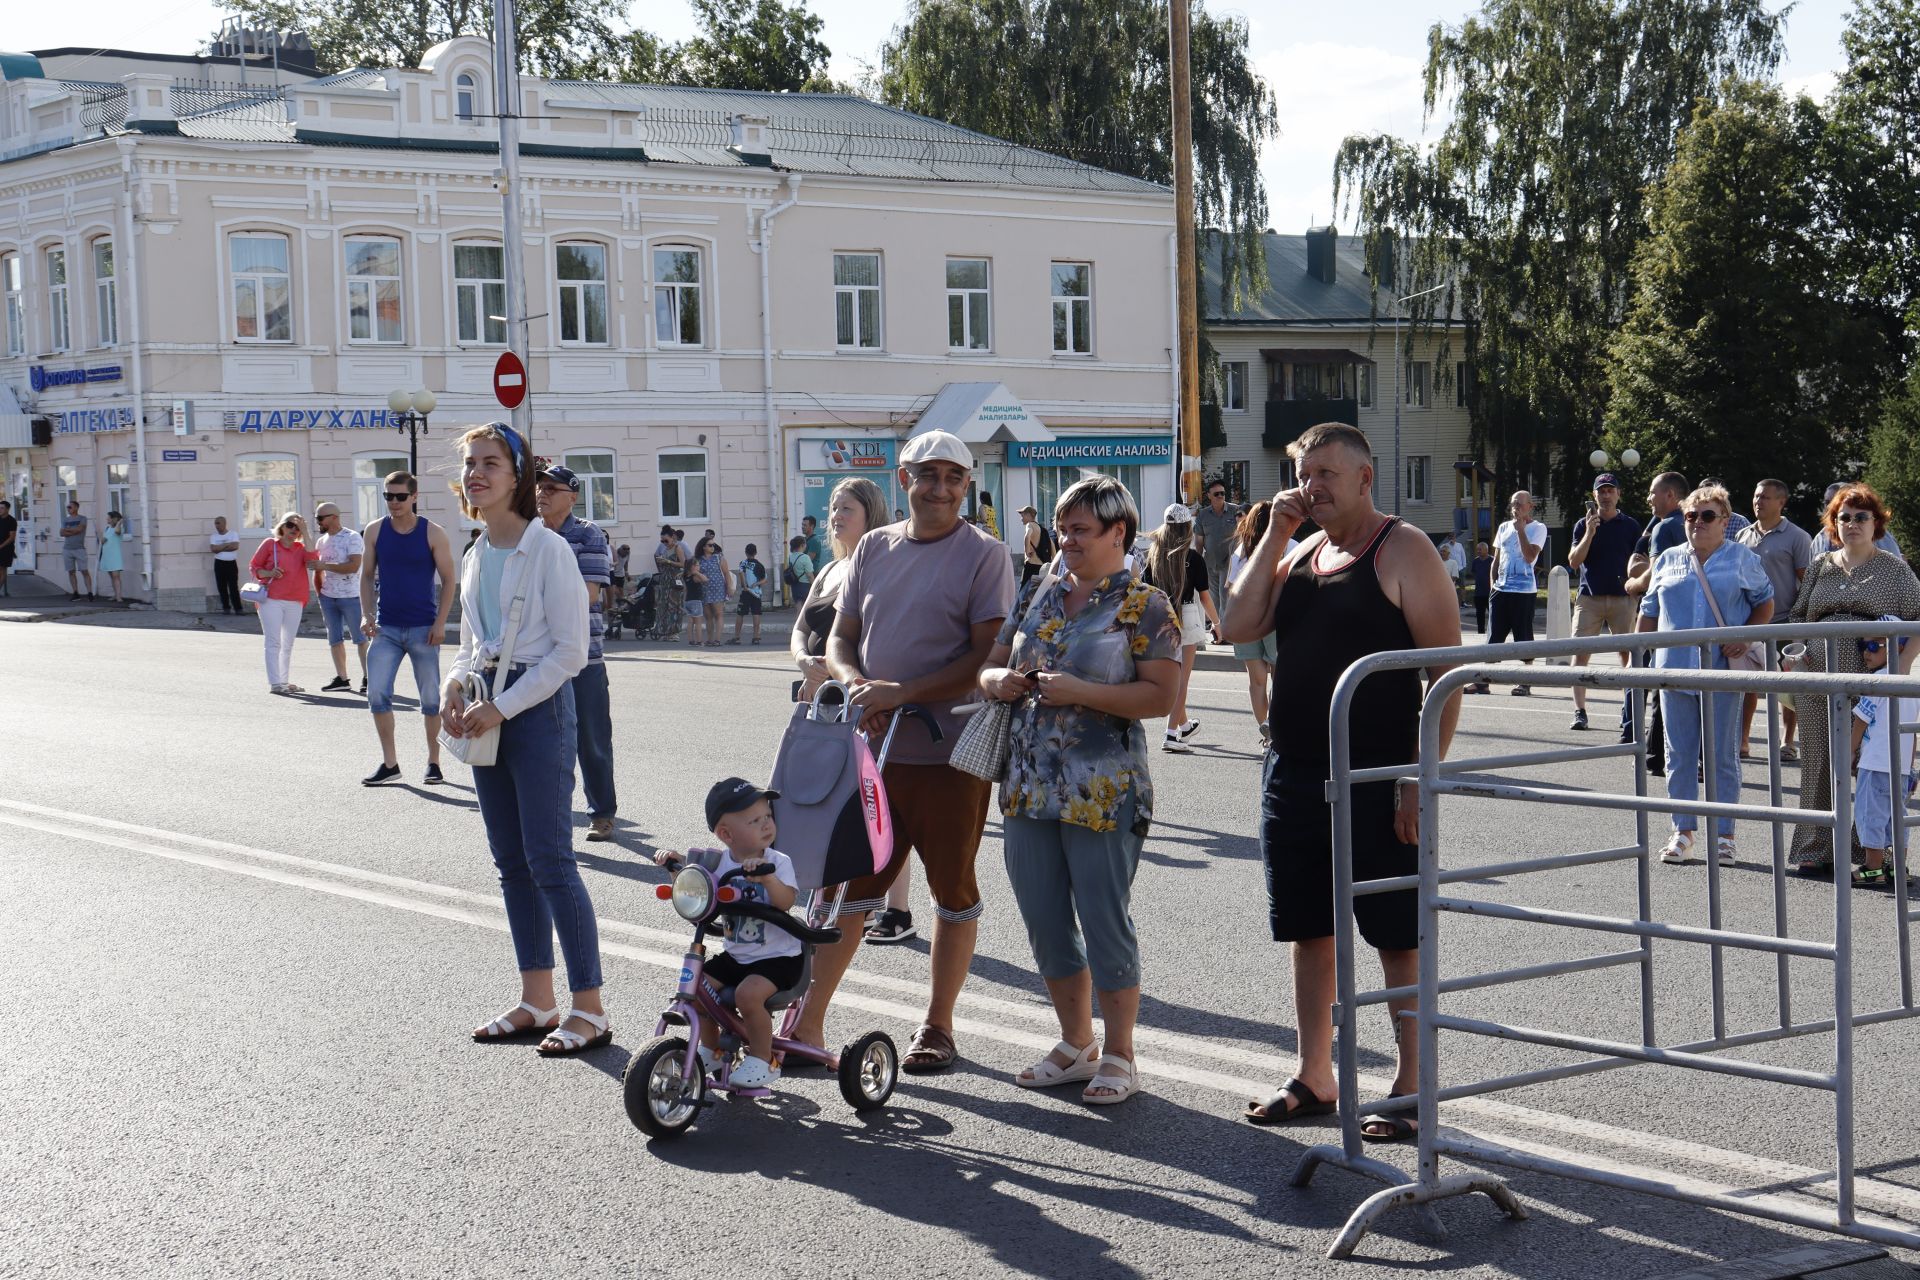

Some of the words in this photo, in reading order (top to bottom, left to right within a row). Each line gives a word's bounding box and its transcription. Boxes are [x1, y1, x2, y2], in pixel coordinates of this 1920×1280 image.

[45, 369, 86, 387] ЮГОРИЯ
[982, 405, 1023, 413] МЕДИЦИНА
[60, 409, 118, 433] АПТЕКА
[852, 442, 886, 456] KDL
[1020, 445, 1112, 460] МЕДИЦИНСКИЕ
[1114, 444, 1171, 457] АНАЛИЗЫ
[864, 778, 877, 821] TRIKE
[703, 977, 721, 1005] TRIKE
